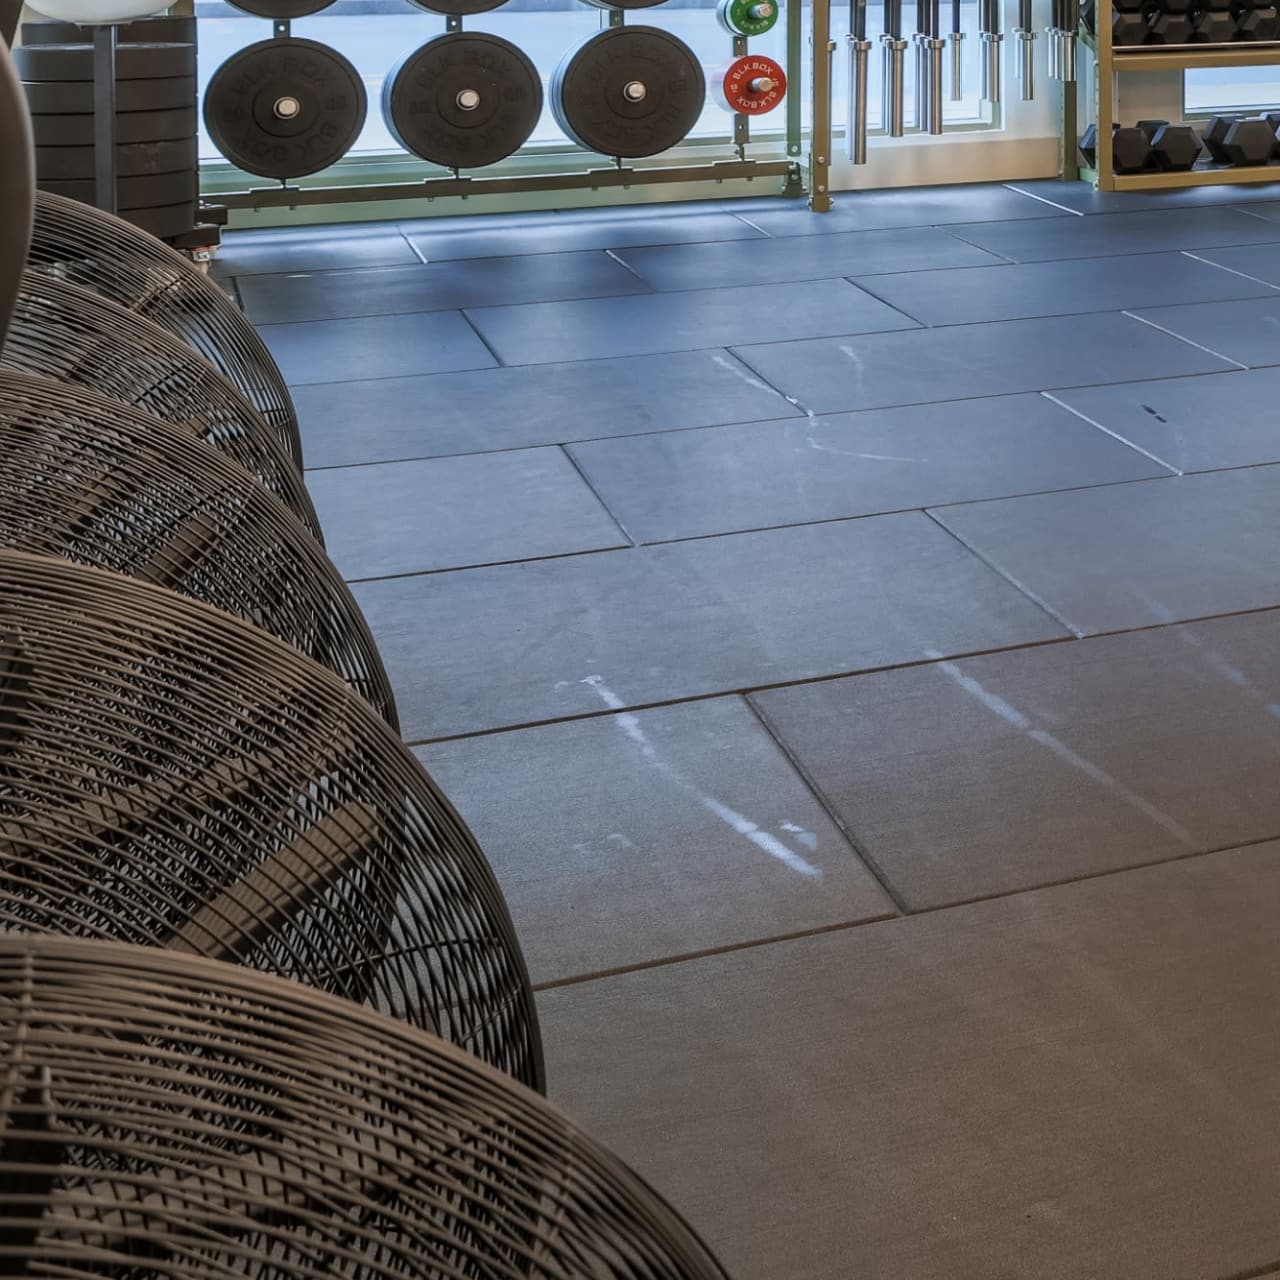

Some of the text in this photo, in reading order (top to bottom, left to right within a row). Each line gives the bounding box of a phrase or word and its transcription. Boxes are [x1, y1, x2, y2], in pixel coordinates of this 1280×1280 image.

[732, 62, 774, 80] BLK BOX
[736, 91, 777, 109] BLK BOX
